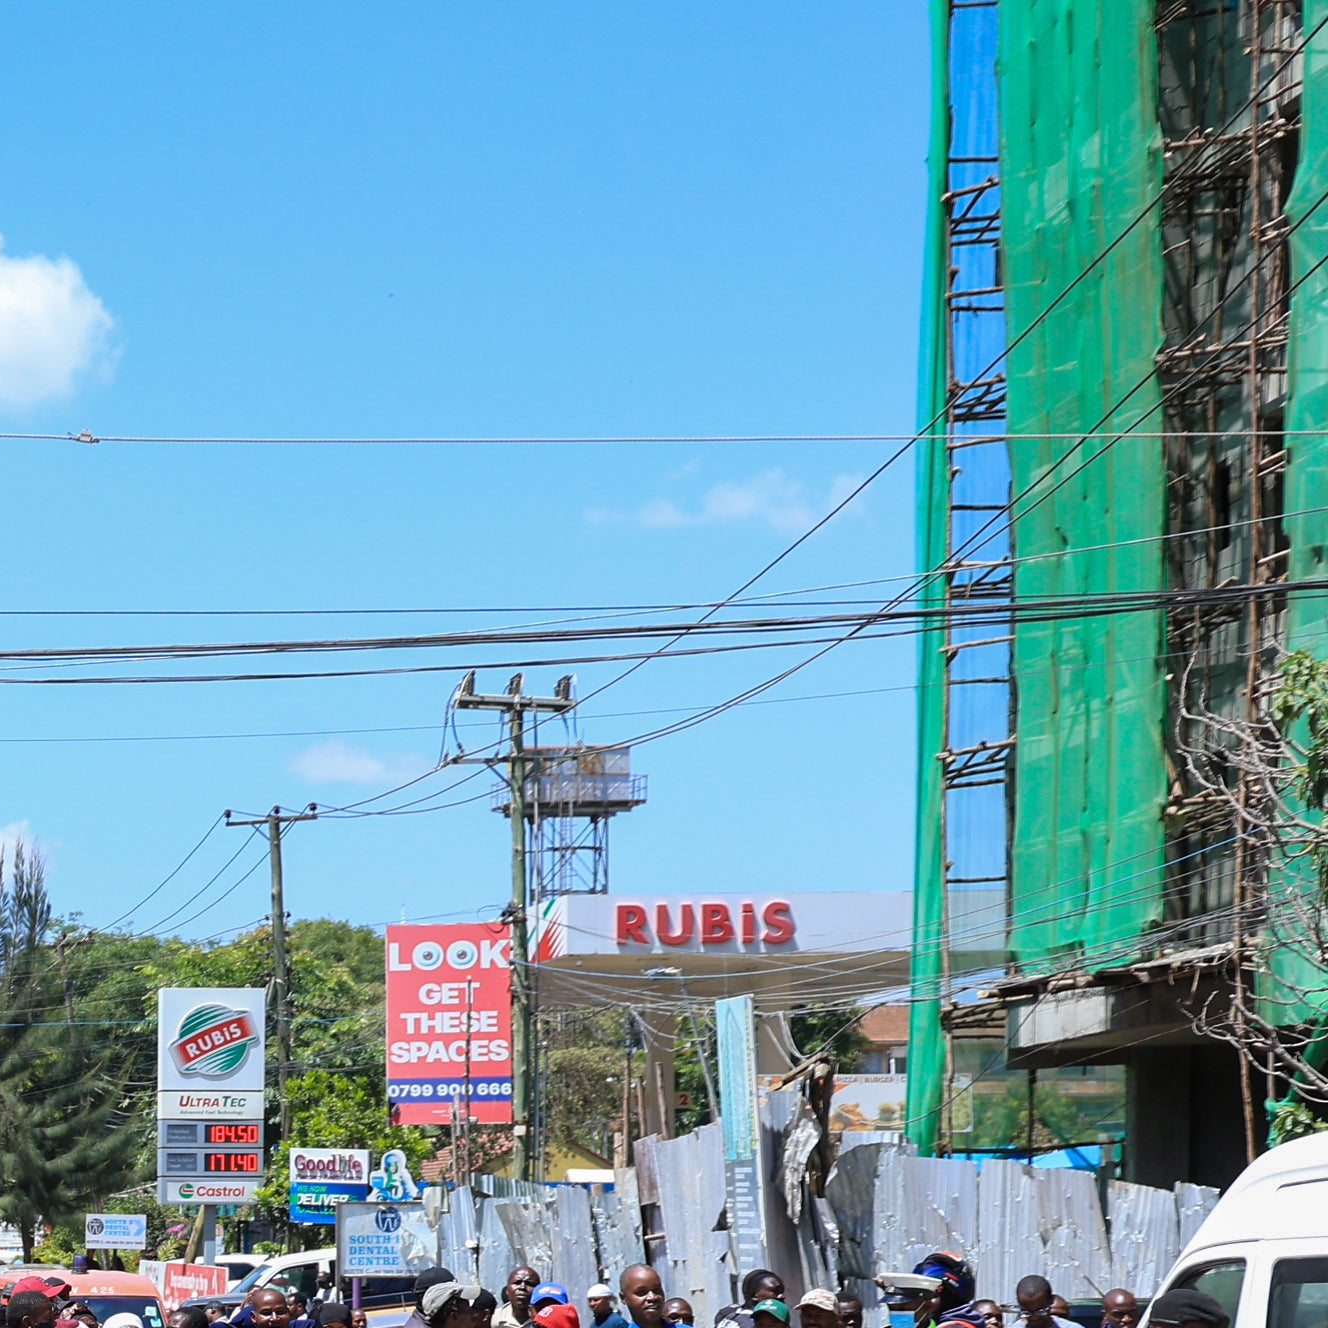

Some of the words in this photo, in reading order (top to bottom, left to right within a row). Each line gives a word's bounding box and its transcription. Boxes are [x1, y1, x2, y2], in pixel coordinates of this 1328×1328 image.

[389, 939, 511, 971] LOOK
[418, 982, 480, 1005] GET
[399, 1010, 499, 1034] THESE
[390, 1039, 509, 1063] SPACES
[388, 1084, 434, 1098] 0799
[476, 1082, 512, 1096] 666
[679, 1093, 689, 1106] 2
[210, 1125, 258, 1143] 184.50
[196, 1186, 246, 1197] Castrol
[349, 1235, 391, 1244] SOUTH
[349, 1246, 397, 1255] DENTAL
[349, 1257, 400, 1266] CENTRE
